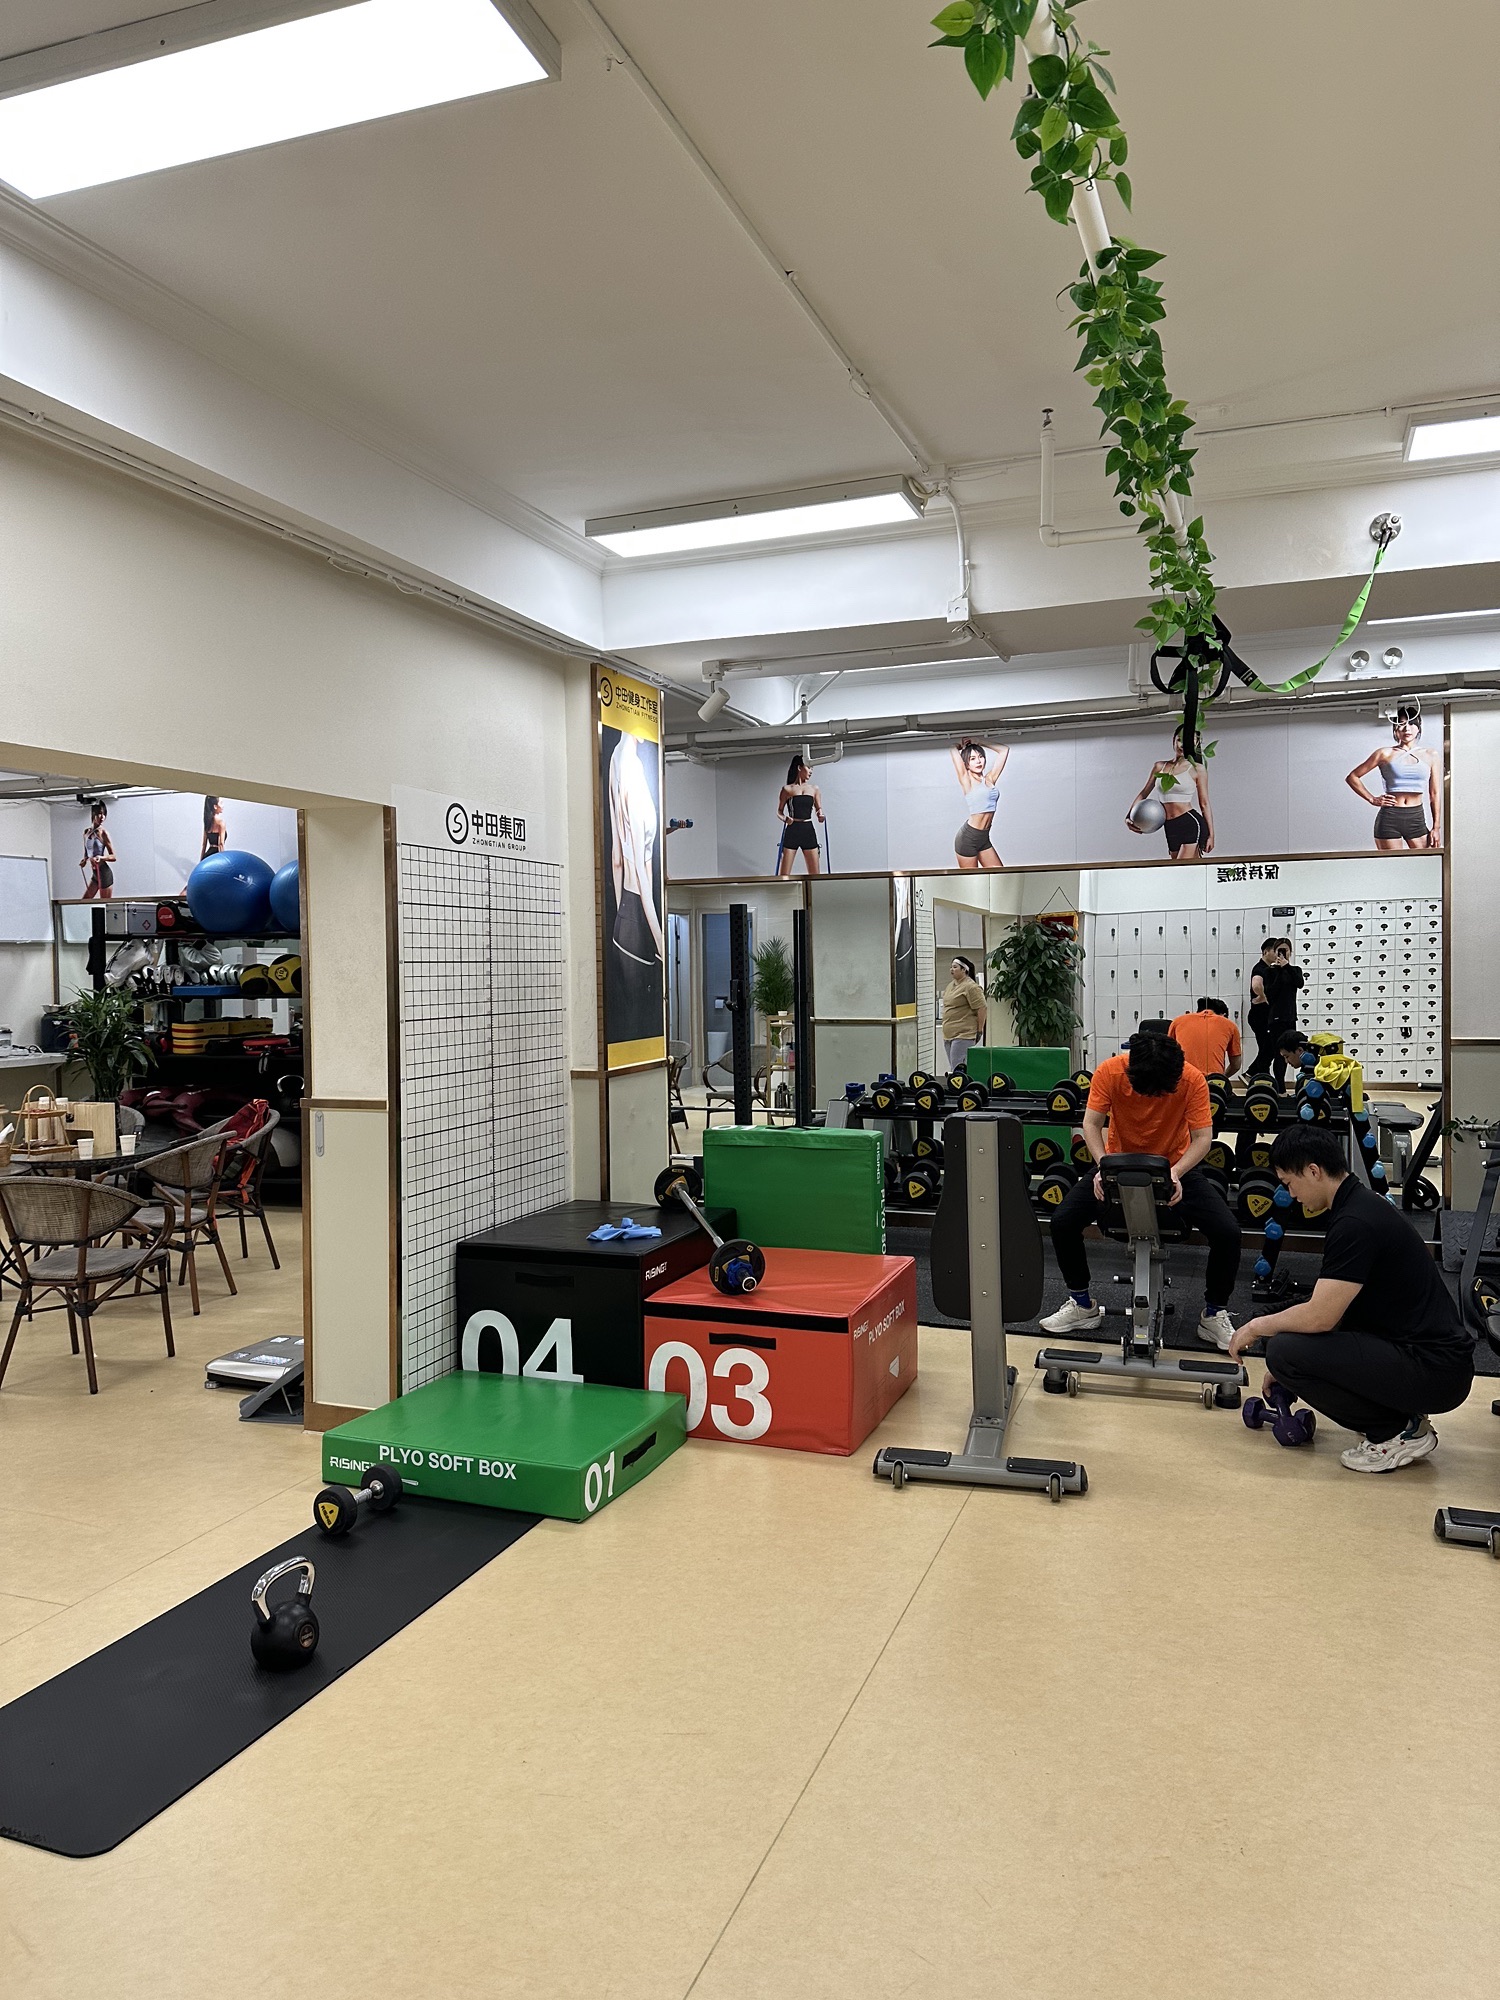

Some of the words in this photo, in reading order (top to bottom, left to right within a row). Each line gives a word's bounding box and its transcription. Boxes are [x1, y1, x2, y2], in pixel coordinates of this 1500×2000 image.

[615, 685, 658, 715] 中田健身工作室
[471, 810, 526, 842] 中田集团
[472, 837, 506, 849] ZHONGTIAN
[507, 842, 526, 852] GROUP
[1253, 1200, 1270, 1214] RISING
[645, 1262, 665, 1280] RISING
[868, 1322, 882, 1346] PLYO
[882, 1309, 895, 1332] SOFT
[895, 1299, 905, 1319] BOX
[461, 1310, 584, 1383] 04
[648, 1341, 773, 1440] 03
[330, 1456, 370, 1472] RISING
[379, 1445, 424, 1467] PLYO
[428, 1452, 474, 1473] SOFT
[478, 1459, 517, 1480] BOX
[585, 1451, 615, 1512] 01
[320, 1505, 332, 1525] RISING
